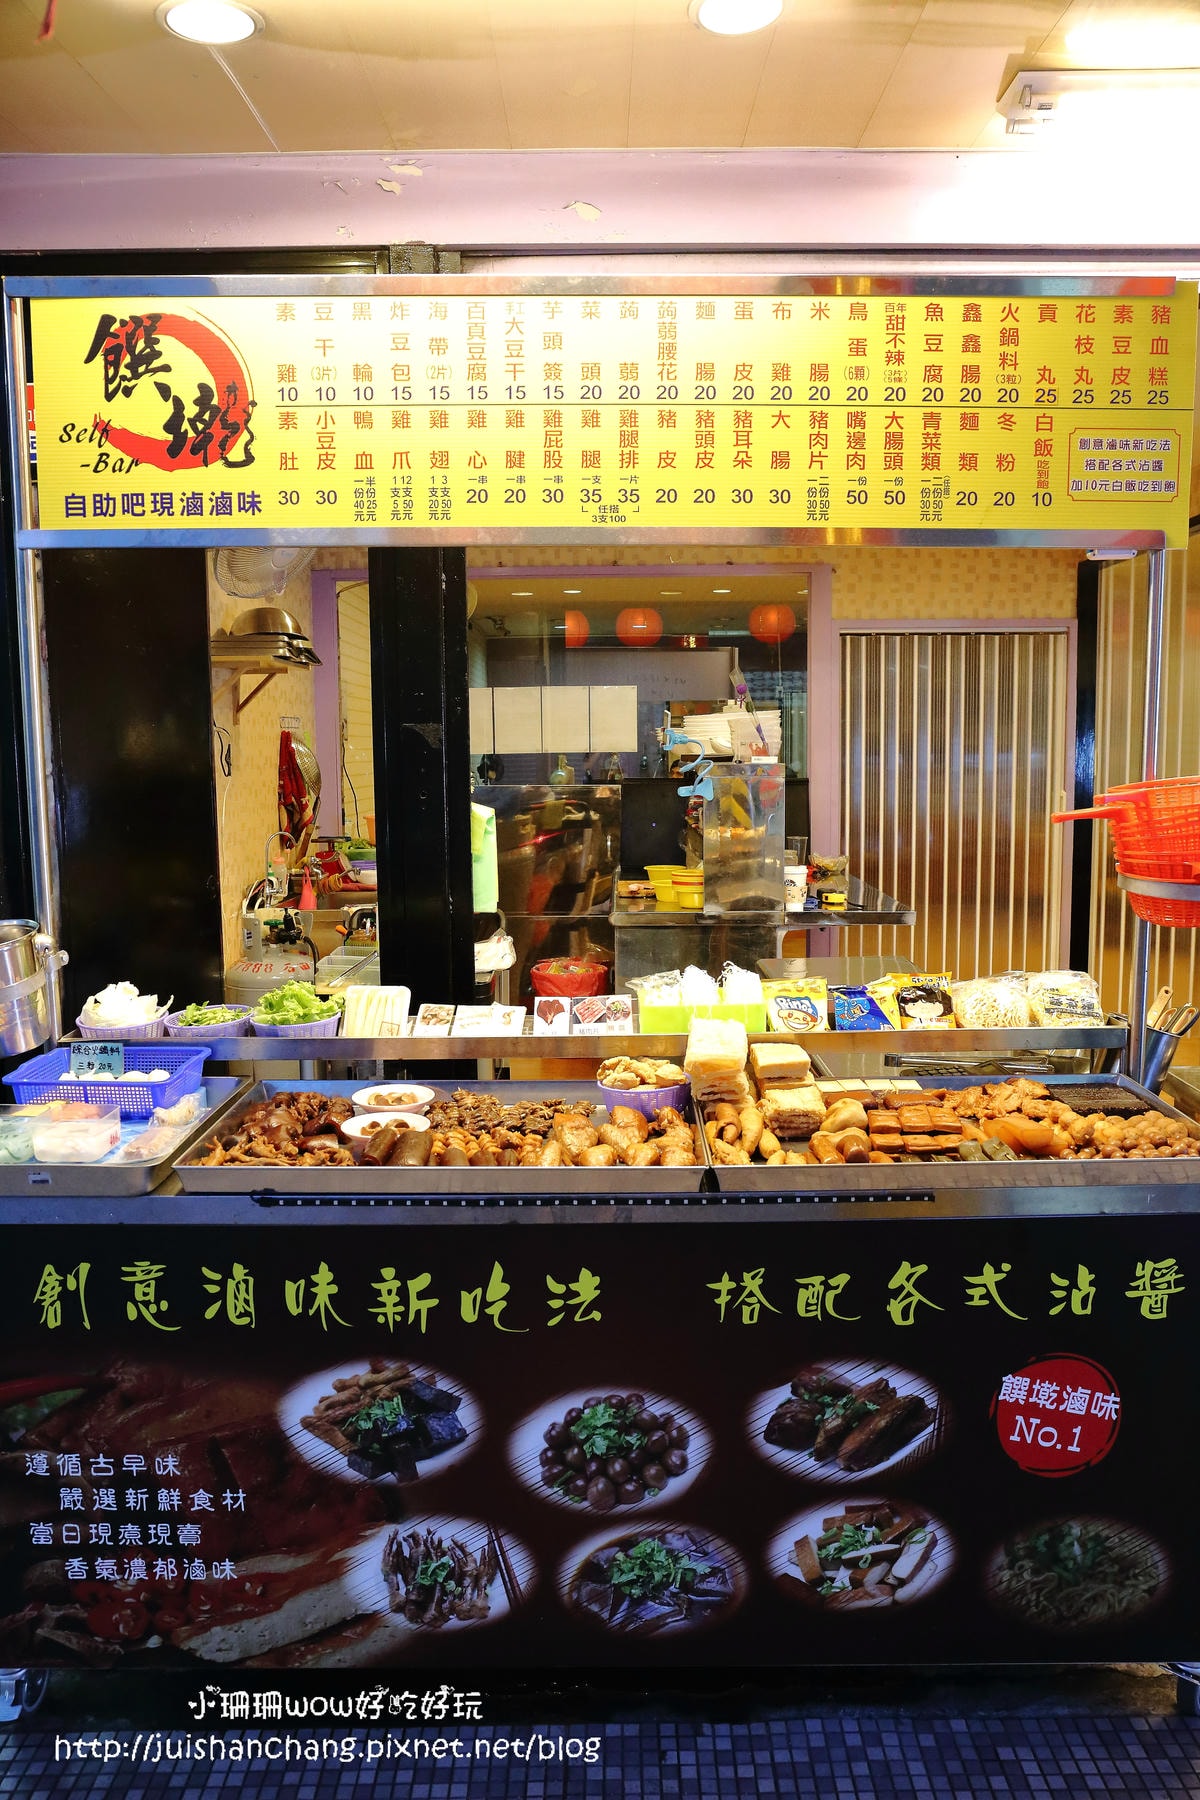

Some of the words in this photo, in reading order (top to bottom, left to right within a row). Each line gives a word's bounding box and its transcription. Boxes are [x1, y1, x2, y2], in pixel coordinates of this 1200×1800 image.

[504, 302, 526, 315] 手工
[884, 302, 907, 313] 百年
[314, 303, 334, 357] 豆干
[429, 302, 448, 356] 海帶
[848, 302, 868, 356] 鳥蛋
[999, 303, 1019, 371] 火鍋料
[391, 302, 411, 381] 炸豆包
[467, 302, 487, 381] 百頁豆腐
[543, 301, 563, 382] 芋頭簽
[657, 301, 677, 382] 蒟蒻腰花
[885, 314, 906, 366] 甜不辣
[923, 303, 944, 383] 魚豆腐
[961, 303, 982, 384] 鑫鑫腸
[1074, 304, 1095, 385] 花枝丸
[1111, 305, 1133, 385] 素豆皮
[1149, 305, 1170, 386] 豬血糕
[505, 317, 525, 381] 大豆干
[311, 366, 336, 381] (3片)
[426, 365, 453, 381] (2片)
[844, 365, 870, 381] (6顆)
[884, 369, 908, 377] (3片)
[995, 374, 1022, 385] (3粒)
[277, 387, 298, 402] 10
[315, 387, 336, 401] 10
[353, 386, 374, 401] 10
[391, 386, 412, 400] 15
[429, 386, 452, 400] 15
[467, 385, 488, 400] 15
[505, 385, 527, 400] 15
[543, 385, 564, 400] 15
[580, 385, 602, 400] 20
[618, 385, 640, 400] 20
[656, 384, 679, 400] 20
[694, 385, 716, 400] 20
[733, 386, 754, 400] 20
[770, 386, 792, 400] 20
[808, 386, 830, 401] 20
[846, 386, 868, 401] 20
[884, 387, 906, 401] 20
[922, 387, 944, 402] 20
[960, 388, 981, 402] 20
[997, 388, 1019, 402] 20
[1035, 388, 1056, 405] 25
[1072, 389, 1094, 404] 25
[1110, 390, 1131, 404] 25
[1147, 390, 1168, 405] 25
[58, 419, 113, 448] Self
[278, 411, 299, 470] 素肚
[316, 411, 336, 470] 小豆皮
[354, 410, 374, 470] 鴨血
[392, 410, 411, 470] 雞爪
[429, 410, 450, 469] 雞翅
[467, 409, 487, 469] 雞心
[504, 410, 525, 469] 雞腱
[543, 409, 563, 469] 雞屁股
[581, 409, 601, 470] 雞腿
[619, 409, 639, 469] 雞腿排
[657, 409, 677, 469] 豬皮
[694, 410, 715, 470] 豬頭皮
[733, 410, 753, 469] 豬耳朵
[771, 410, 790, 469] 大腸
[809, 410, 828, 470] 豬肉片
[846, 411, 866, 470] 嘴邊肉
[883, 411, 904, 470] 大腸頭
[921, 411, 942, 471] 青菜類
[959, 412, 979, 471] 麵類
[1033, 412, 1054, 458] 白飯
[996, 412, 1016, 472] 冬粉
[1078, 438, 1172, 451] 創意滷味新吃法
[1084, 459, 1164, 472] 搭配各式沾醬
[468, 475, 488, 484] 一串
[506, 475, 526, 485] 一串
[544, 475, 563, 484] 一串
[581, 475, 602, 485] 一支
[620, 475, 639, 484] 一片
[848, 476, 867, 486] 一份
[884, 477, 903, 486] 一份
[1037, 460, 1049, 489] 吃到飽
[1070, 480, 1176, 493] 加10元白飯吃到飽
[278, 489, 300, 505] 30
[316, 488, 337, 505] 30
[466, 489, 488, 504] 20
[504, 488, 526, 504] 20
[542, 488, 564, 503] 30
[580, 489, 602, 503] 35
[618, 489, 640, 503] 35
[656, 488, 679, 504] 20
[692, 489, 715, 503] 20
[731, 489, 753, 504] 30
[769, 489, 791, 504] 30
[847, 490, 868, 504] 50
[884, 490, 905, 505] 50
[956, 491, 978, 506] 20
[993, 492, 1015, 506] 20
[1032, 492, 1052, 506] 10
[64, 491, 262, 518] 自助吧現滷滷味
[598, 504, 621, 515] 任搭
[591, 515, 626, 523] 3支100
[33, 1260, 602, 1333] 創意滷味新吃法
[706, 1258, 1186, 1326] 搭配各式沾醬
[25, 1453, 181, 1477] 遵循古早味
[59, 1488, 247, 1512] 嚴選新鮮食材
[30, 1522, 201, 1546] 當日現煮現賣
[64, 1557, 238, 1581] 香氣濃郁滷味
